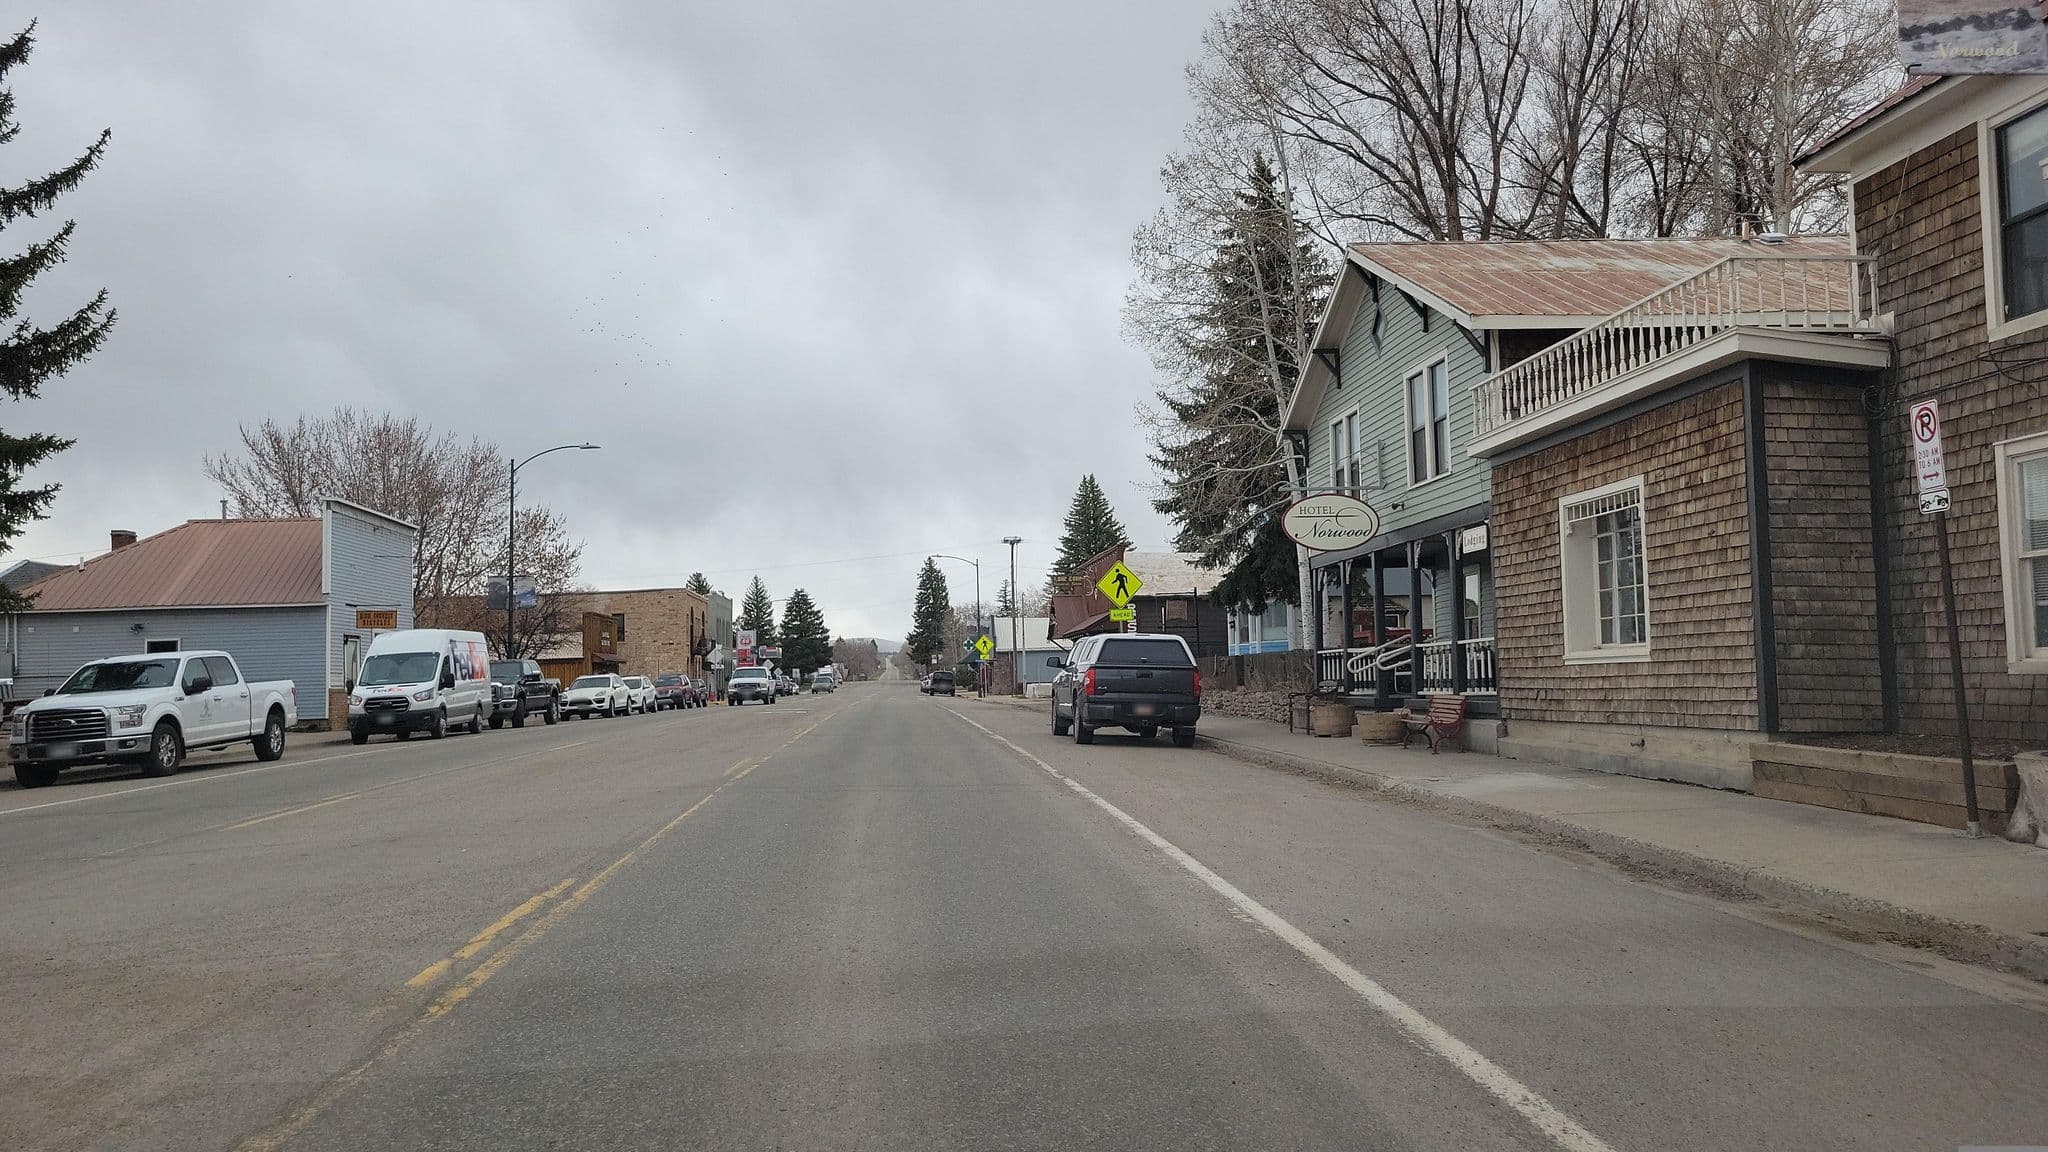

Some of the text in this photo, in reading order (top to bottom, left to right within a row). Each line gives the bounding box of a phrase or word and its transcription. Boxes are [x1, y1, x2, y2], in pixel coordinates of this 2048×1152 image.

[1938, 42, 2018, 58] Norwood
[1931, 447, 1939, 455] AM
[1919, 460, 1926, 469] TO
[1933, 457, 1940, 465] AM
[1300, 506, 1335, 515] HOTEL
[1295, 513, 1373, 539] Norwood
